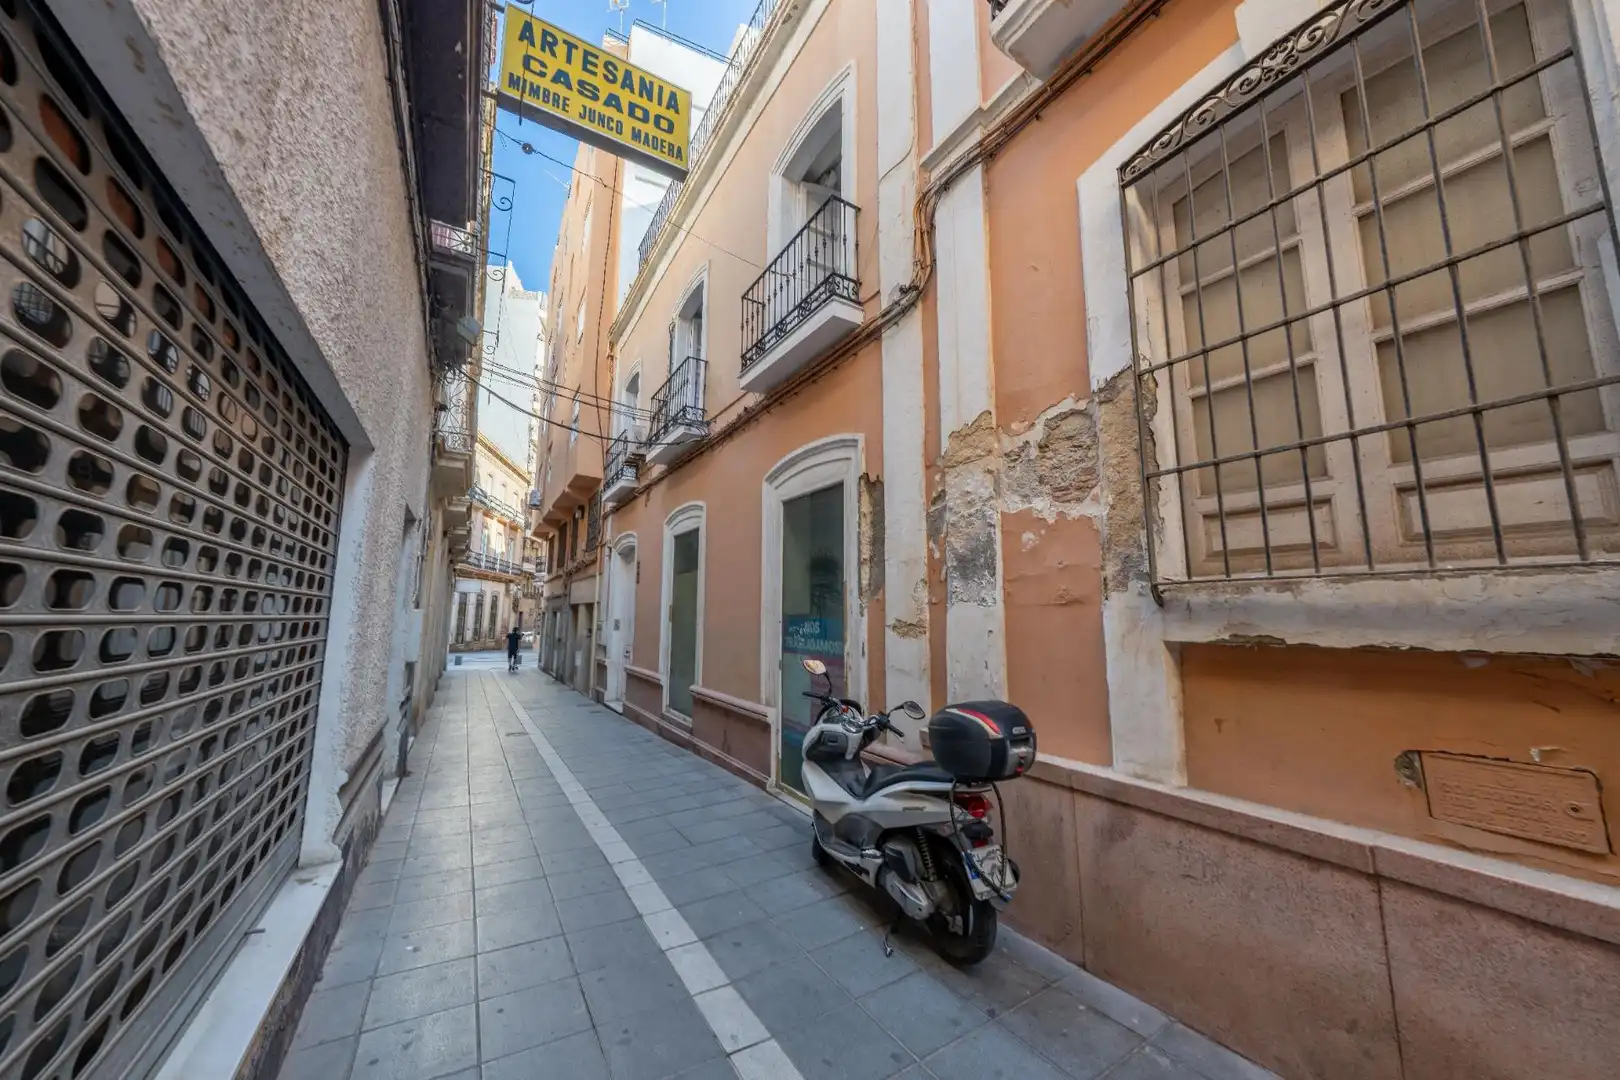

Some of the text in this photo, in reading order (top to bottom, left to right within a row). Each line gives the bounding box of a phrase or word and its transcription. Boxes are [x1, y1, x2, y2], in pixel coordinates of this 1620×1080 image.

[518, 20, 680, 114] ARTESANIA
[523, 54, 675, 134] CASADO
[508, 72, 684, 161] MIMBRE JUNCO MADERA
